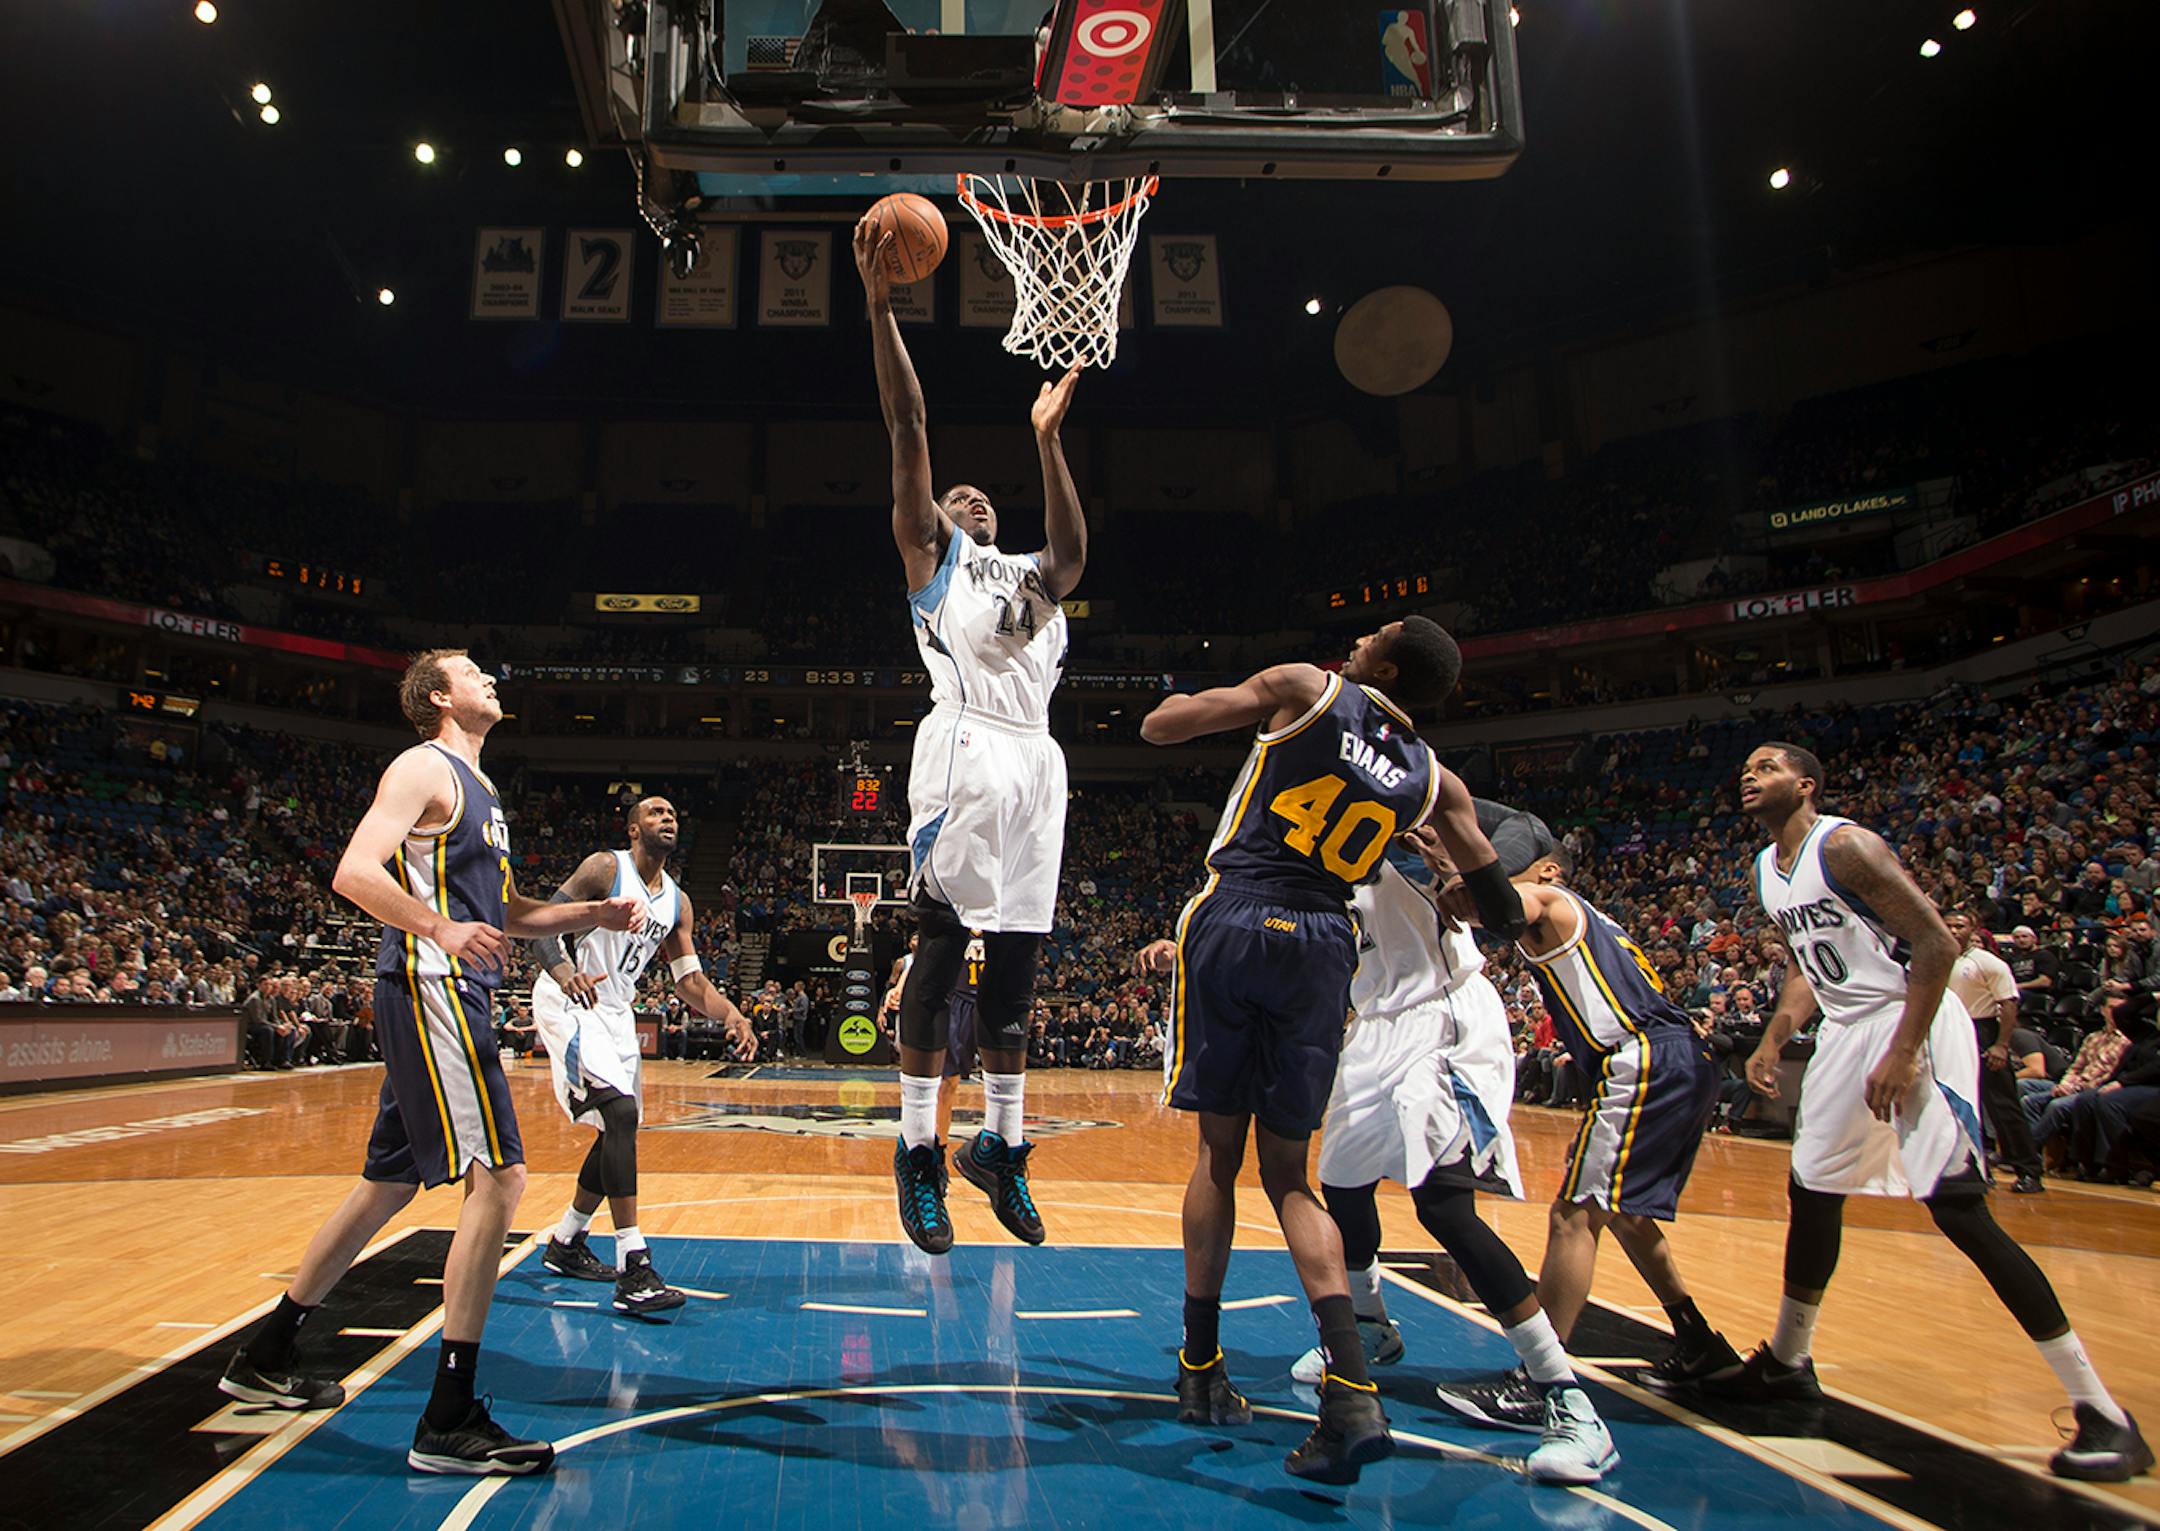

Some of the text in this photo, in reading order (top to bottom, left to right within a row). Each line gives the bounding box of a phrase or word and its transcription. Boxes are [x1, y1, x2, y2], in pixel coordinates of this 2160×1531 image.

[577, 238, 620, 300] 2
[784, 287, 806, 297] 2011
[767, 308, 821, 318] CHAMPIONS
[2131, 478, 2160, 509] PH
[1791, 505, 1828, 524] LAND
[993, 593, 1035, 642] 24
[744, 671, 769, 683] 23
[804, 670, 857, 685] 8:33
[900, 672, 927, 685] 27
[1339, 731, 1408, 789] EVANS
[851, 791, 878, 811] 22
[1269, 773, 1397, 883] 40
[1263, 917, 1297, 932] UTAH
[618, 940, 644, 973] 15
[8, 1034, 66, 1067] assists
[68, 1033, 113, 1063] alone.
